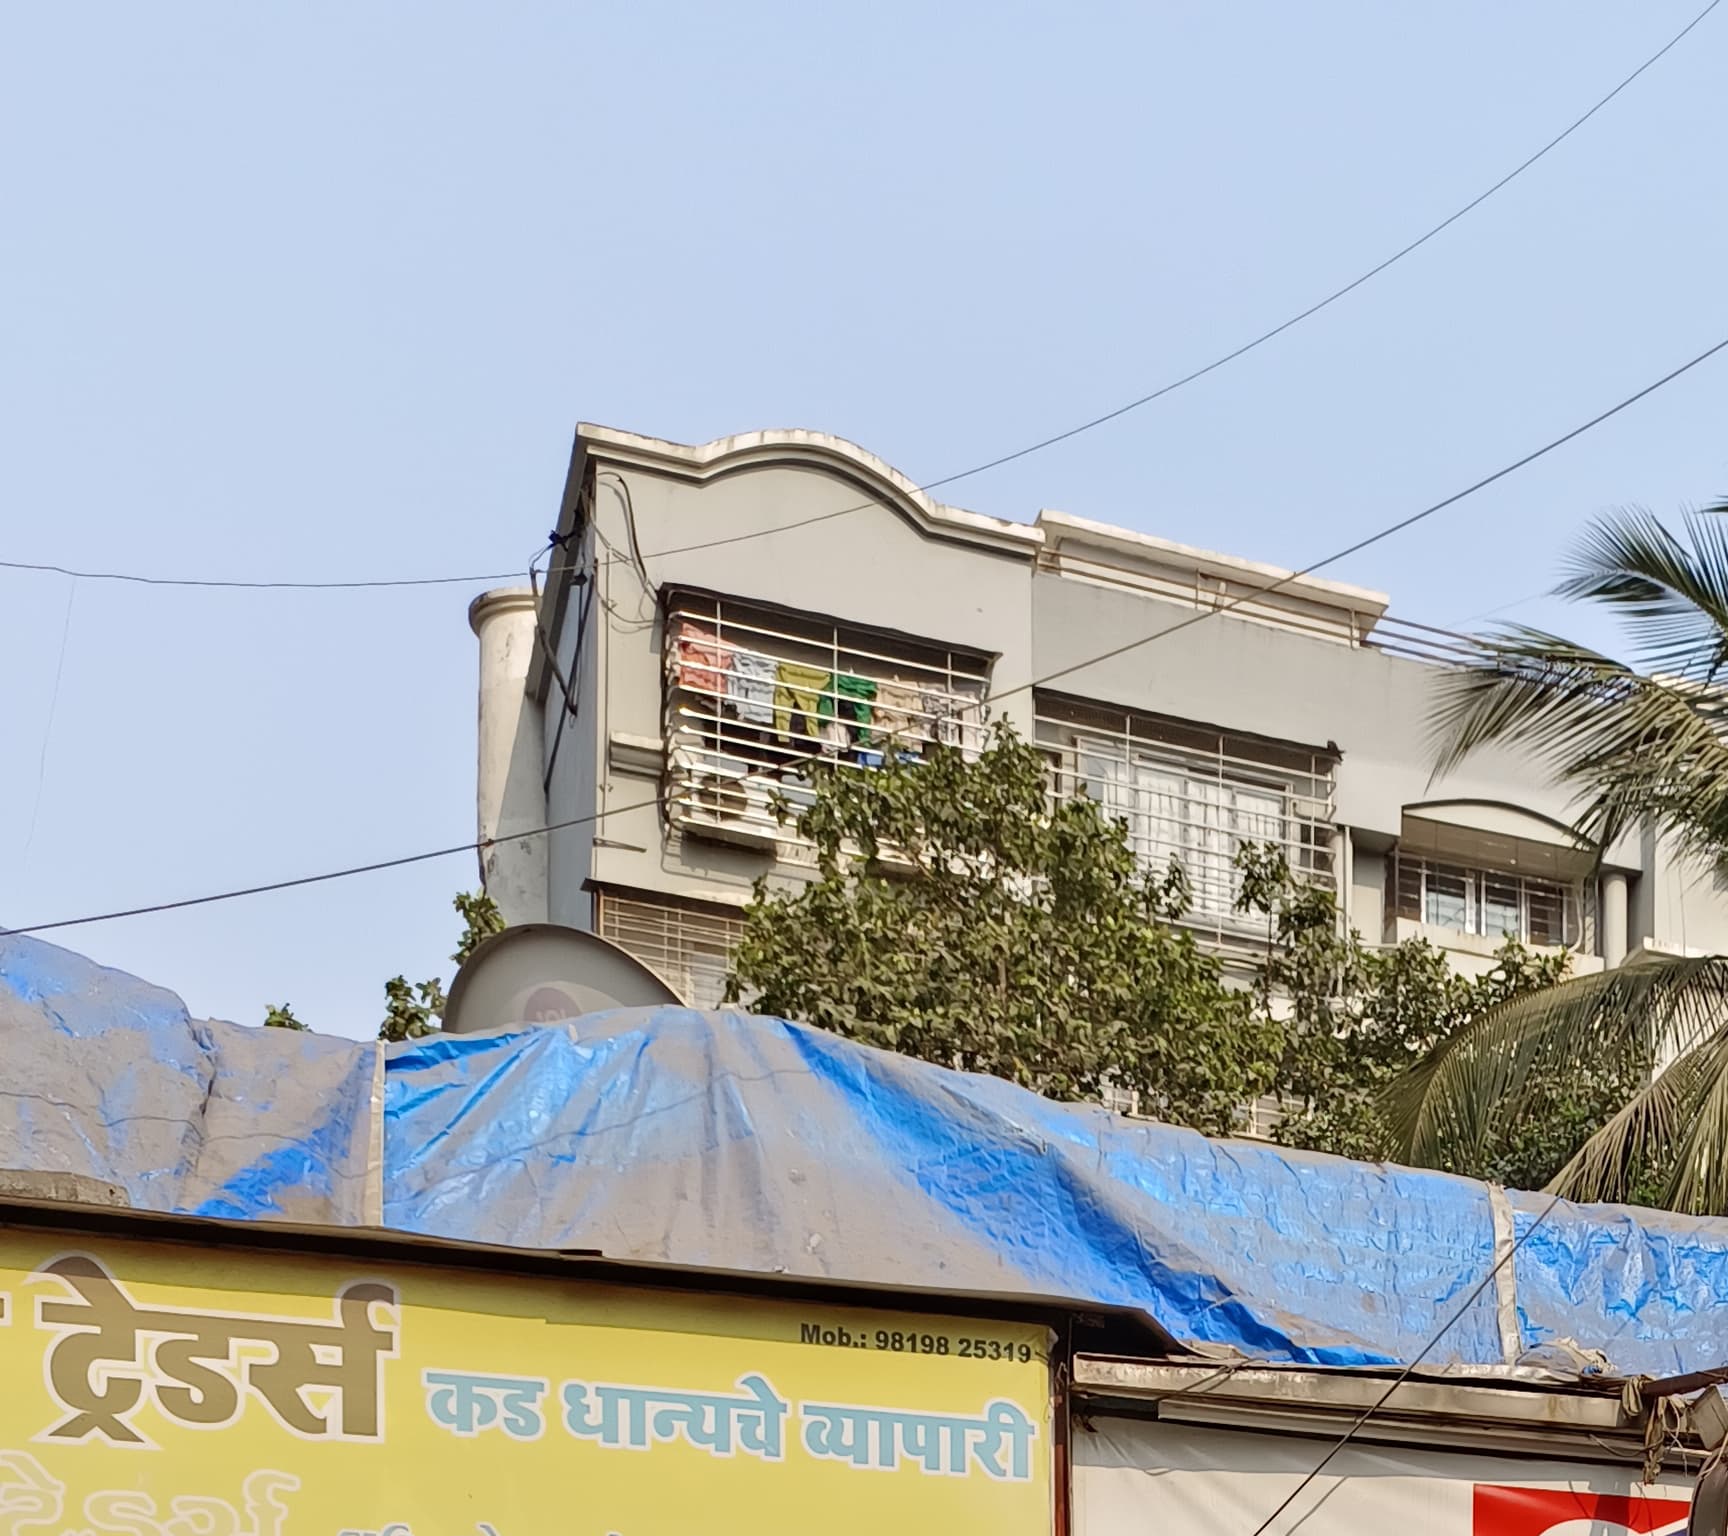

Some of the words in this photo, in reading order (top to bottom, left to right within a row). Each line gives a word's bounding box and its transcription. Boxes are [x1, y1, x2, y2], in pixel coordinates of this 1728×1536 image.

[31, 1254, 398, 1445] ट्रेडर्स
[801, 1323, 867, 1349] Mob.:
[876, 1330, 949, 1356] 98198
[958, 1338, 1031, 1363] 25319
[423, 1369, 547, 1439] कड
[564, 1374, 787, 1460] धान्यचे
[801, 1400, 1035, 1480] व्यापारी
